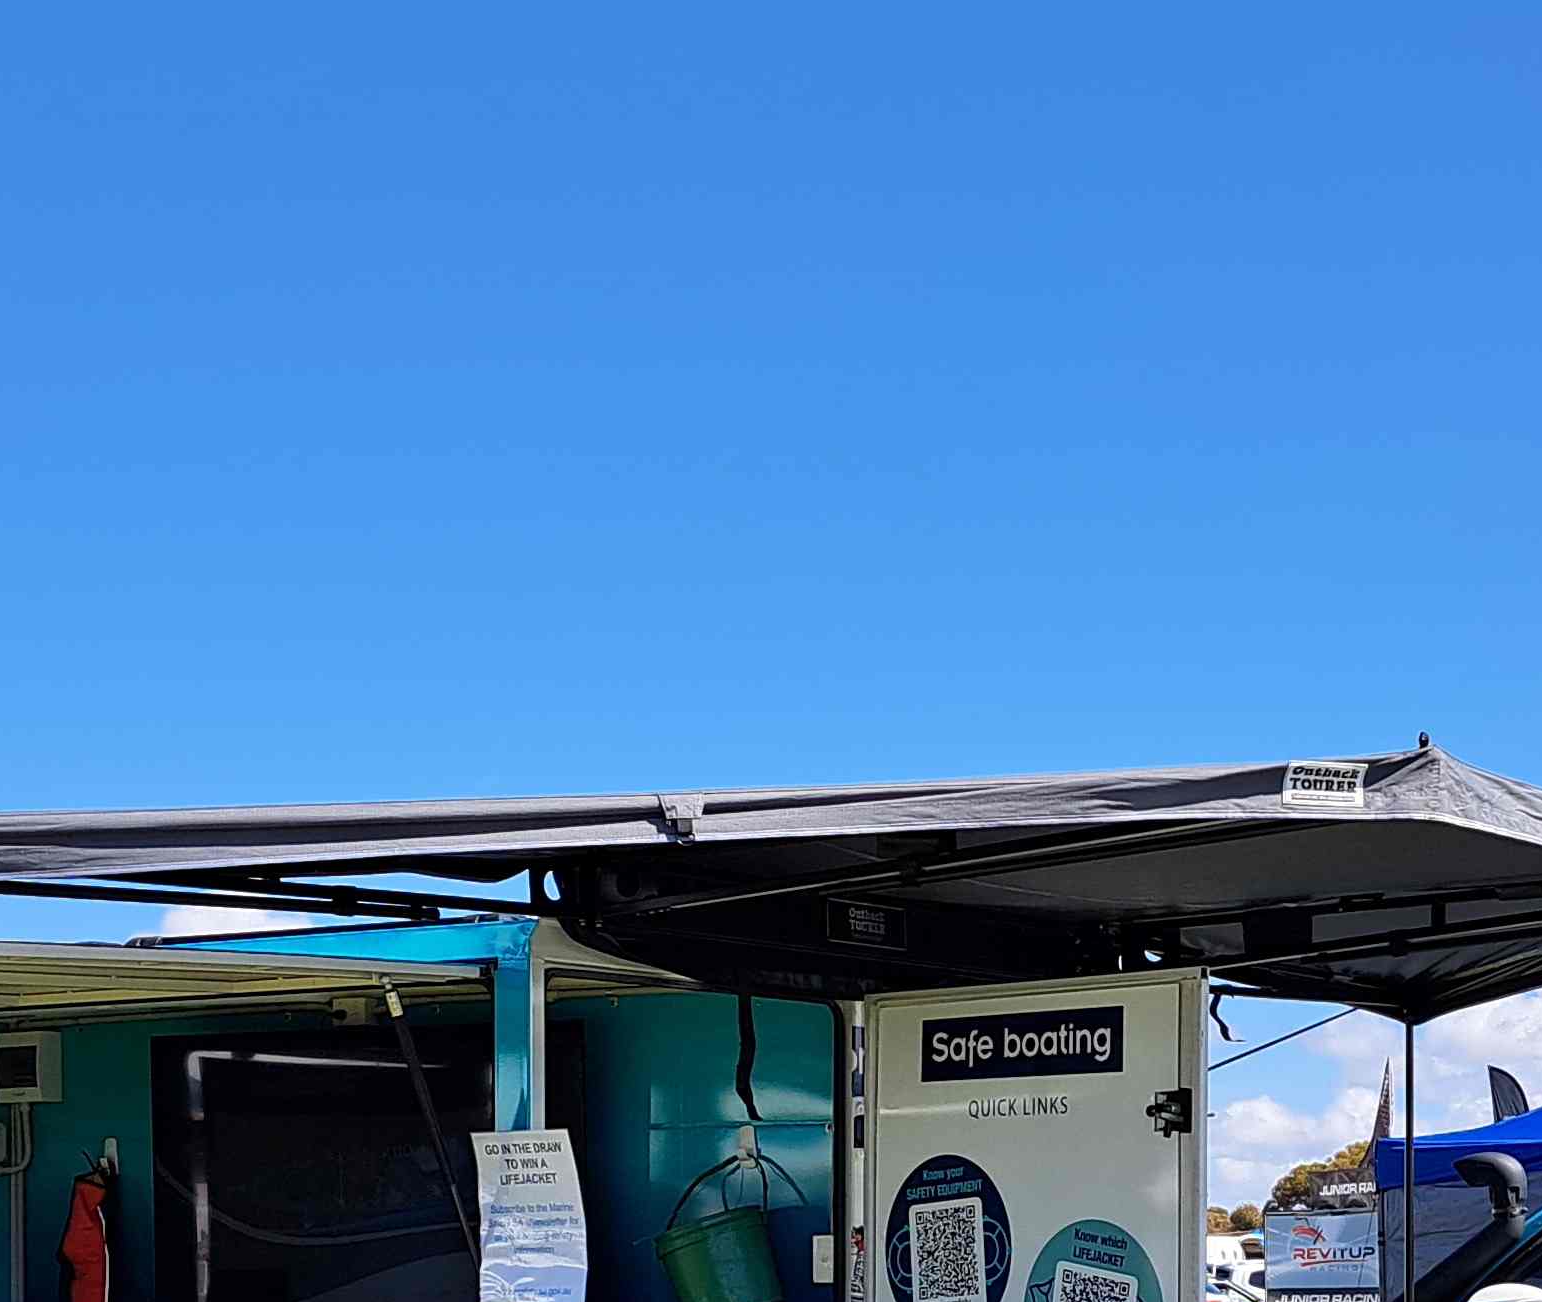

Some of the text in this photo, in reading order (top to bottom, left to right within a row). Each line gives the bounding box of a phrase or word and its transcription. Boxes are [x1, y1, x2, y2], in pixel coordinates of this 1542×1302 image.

[1292, 766, 1360, 779] Outback
[1289, 777, 1357, 793] TOURER
[932, 1023, 1111, 1068] Safe boating
[968, 1096, 1069, 1119] QUICK LINKS
[484, 1142, 562, 1156] GO IN THE DRAW
[505, 1158, 548, 1170] TO WIN A
[500, 1173, 557, 1186] LIFEJACKET
[906, 1179, 983, 1200] SAFETY EQUIPMENT
[1320, 1183, 1358, 1196] JUNIOR
[1073, 1241, 1126, 1268] LIFEJACKET
[1293, 1245, 1376, 1260] REVITUP
